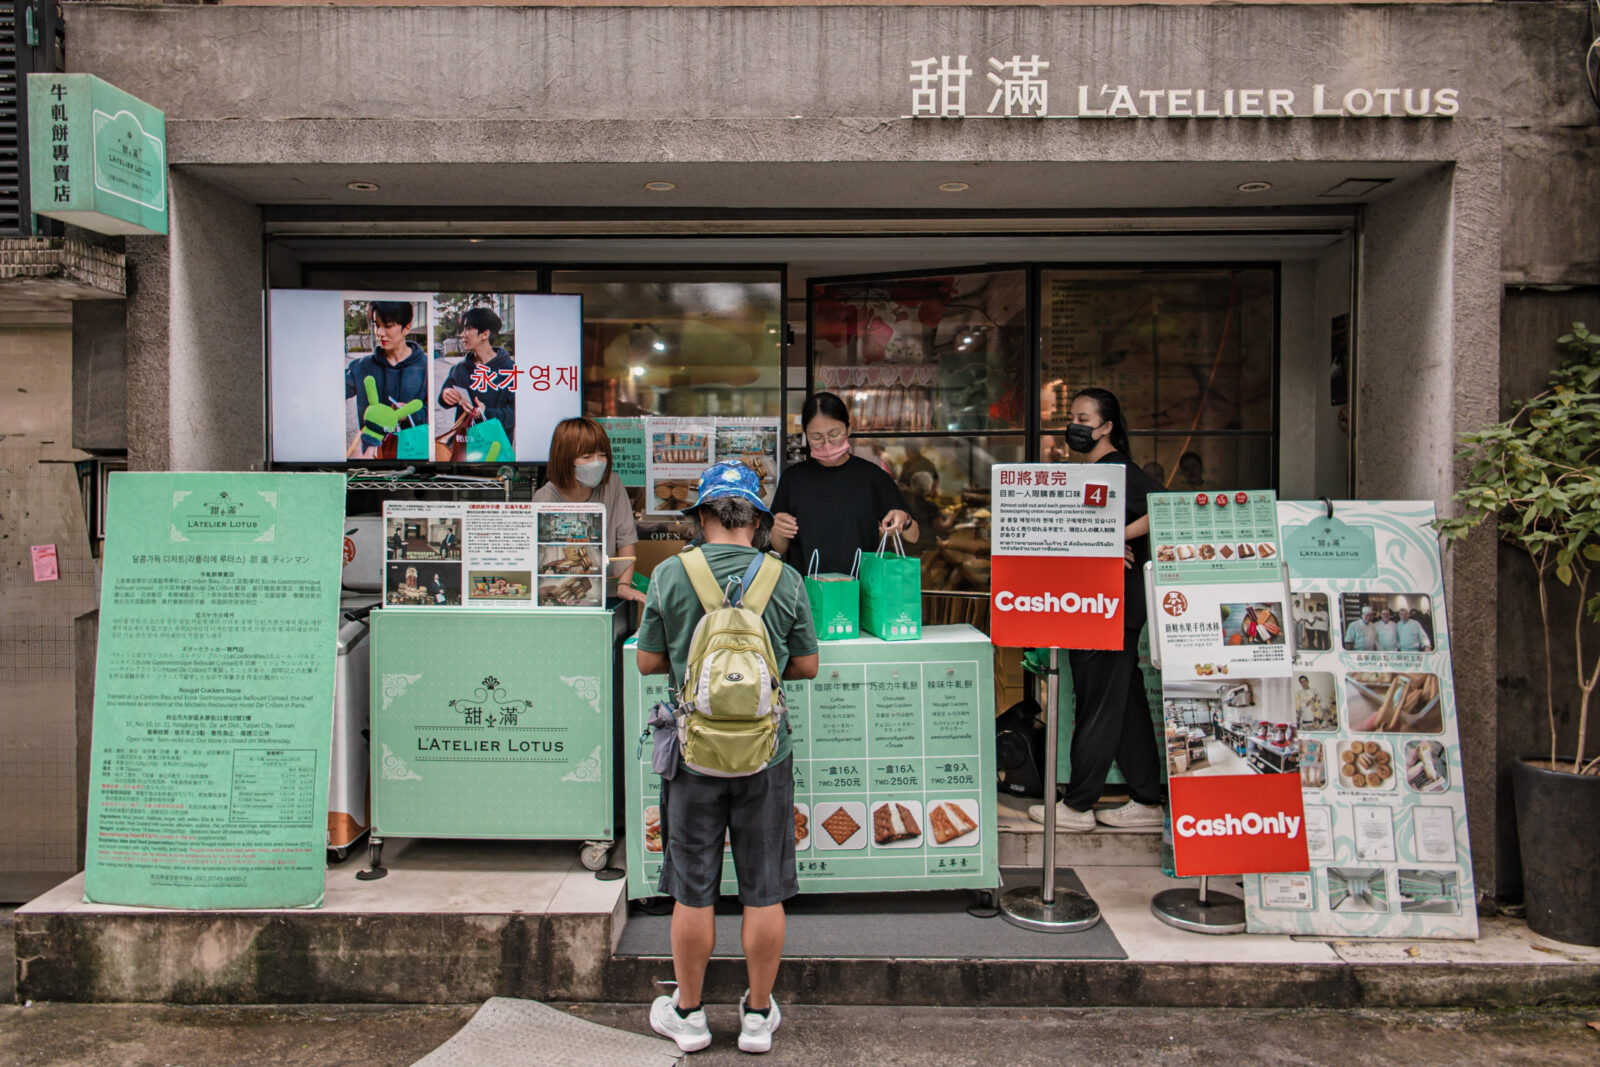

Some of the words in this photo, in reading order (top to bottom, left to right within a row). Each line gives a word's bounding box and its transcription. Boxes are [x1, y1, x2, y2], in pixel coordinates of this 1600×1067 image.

[909, 54, 1050, 117] 甜滿
[1078, 84, 1295, 117] L'ATELIER
[1312, 84, 1461, 117] LOTUS
[50, 83, 70, 202] 牛軋餅專賣店
[1000, 470, 1067, 486] 即將賣完
[1089, 487, 1102, 504] 4
[1108, 490, 1116, 498] 盒
[230, 520, 258, 528] LOTUS
[651, 532, 681, 540] OPEN
[994, 590, 1119, 619] CashOnly
[870, 681, 918, 691] 巧克力牛軋餅
[464, 706, 518, 726] 甜滿
[418, 737, 500, 751] L'ATELIER
[508, 739, 564, 752] LOTUS
[820, 766, 858, 775] 一盒16入
[877, 764, 915, 773] 一盒16入
[935, 763, 969, 772] 一盒9入
[1176, 811, 1301, 839] CashOnly
